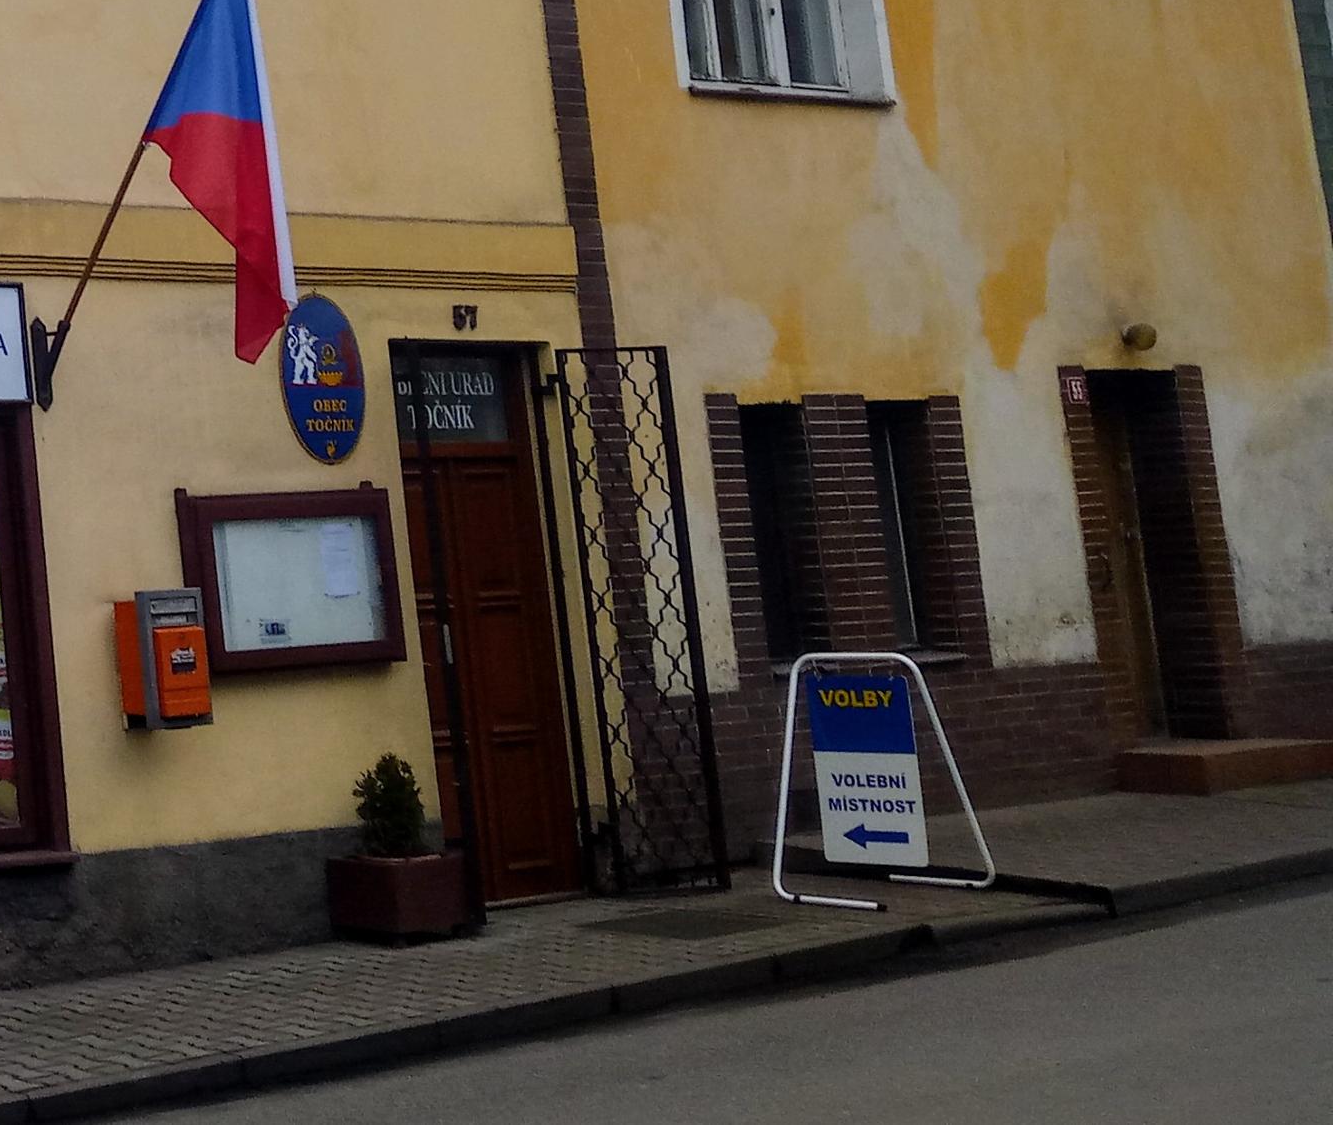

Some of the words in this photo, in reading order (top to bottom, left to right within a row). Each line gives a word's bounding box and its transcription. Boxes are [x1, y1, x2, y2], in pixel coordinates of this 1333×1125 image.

[313, 398, 347, 412] OBEC
[818, 689, 893, 708] VOLBY
[831, 771, 907, 790] VOLEBNÍ
[828, 794, 916, 814] MÍSTNOST
